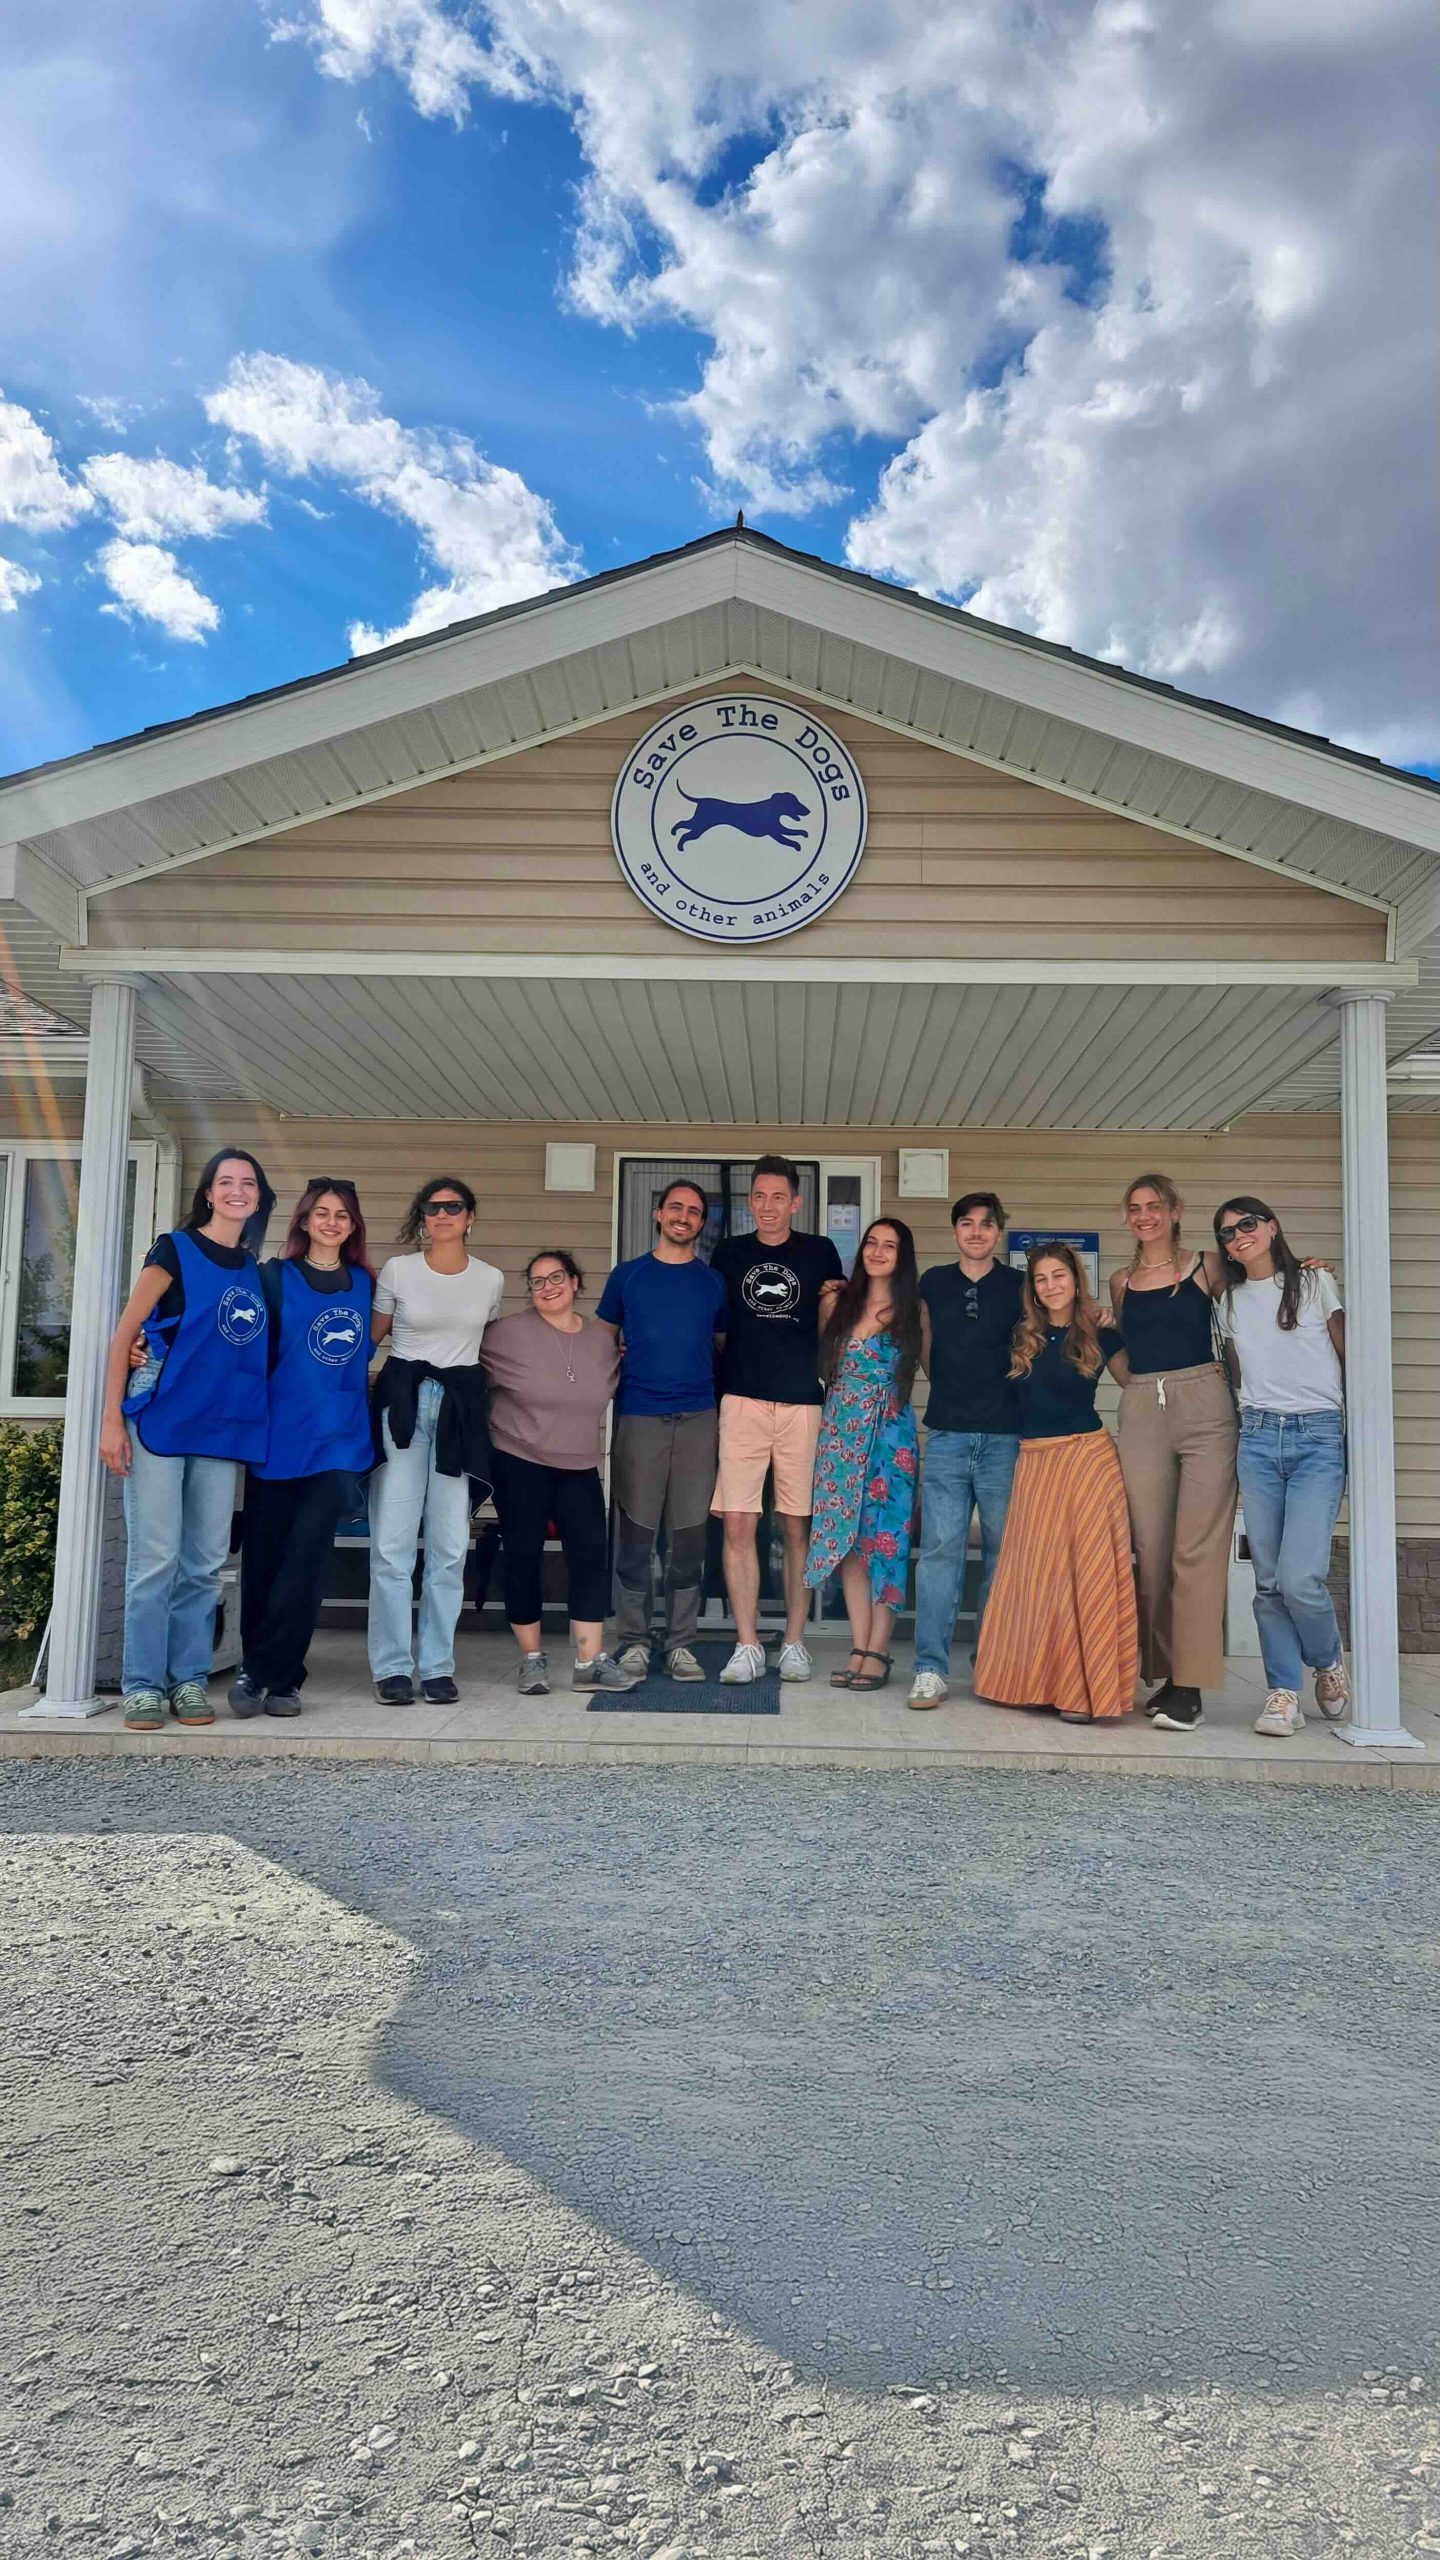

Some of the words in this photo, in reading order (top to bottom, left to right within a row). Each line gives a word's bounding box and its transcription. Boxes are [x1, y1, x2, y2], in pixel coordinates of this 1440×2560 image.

[633, 724, 698, 789] Save
[717, 704, 779, 730] The
[795, 725, 850, 801] Dogs
[640, 861, 671, 896] and
[675, 900, 738, 926] other
[753, 872, 831, 925] animals
[746, 1268, 760, 1285] Save
[782, 1269, 797, 1286] Dogs
[223, 1290, 236, 1307] Save
[313, 1314, 330, 1332] Save
